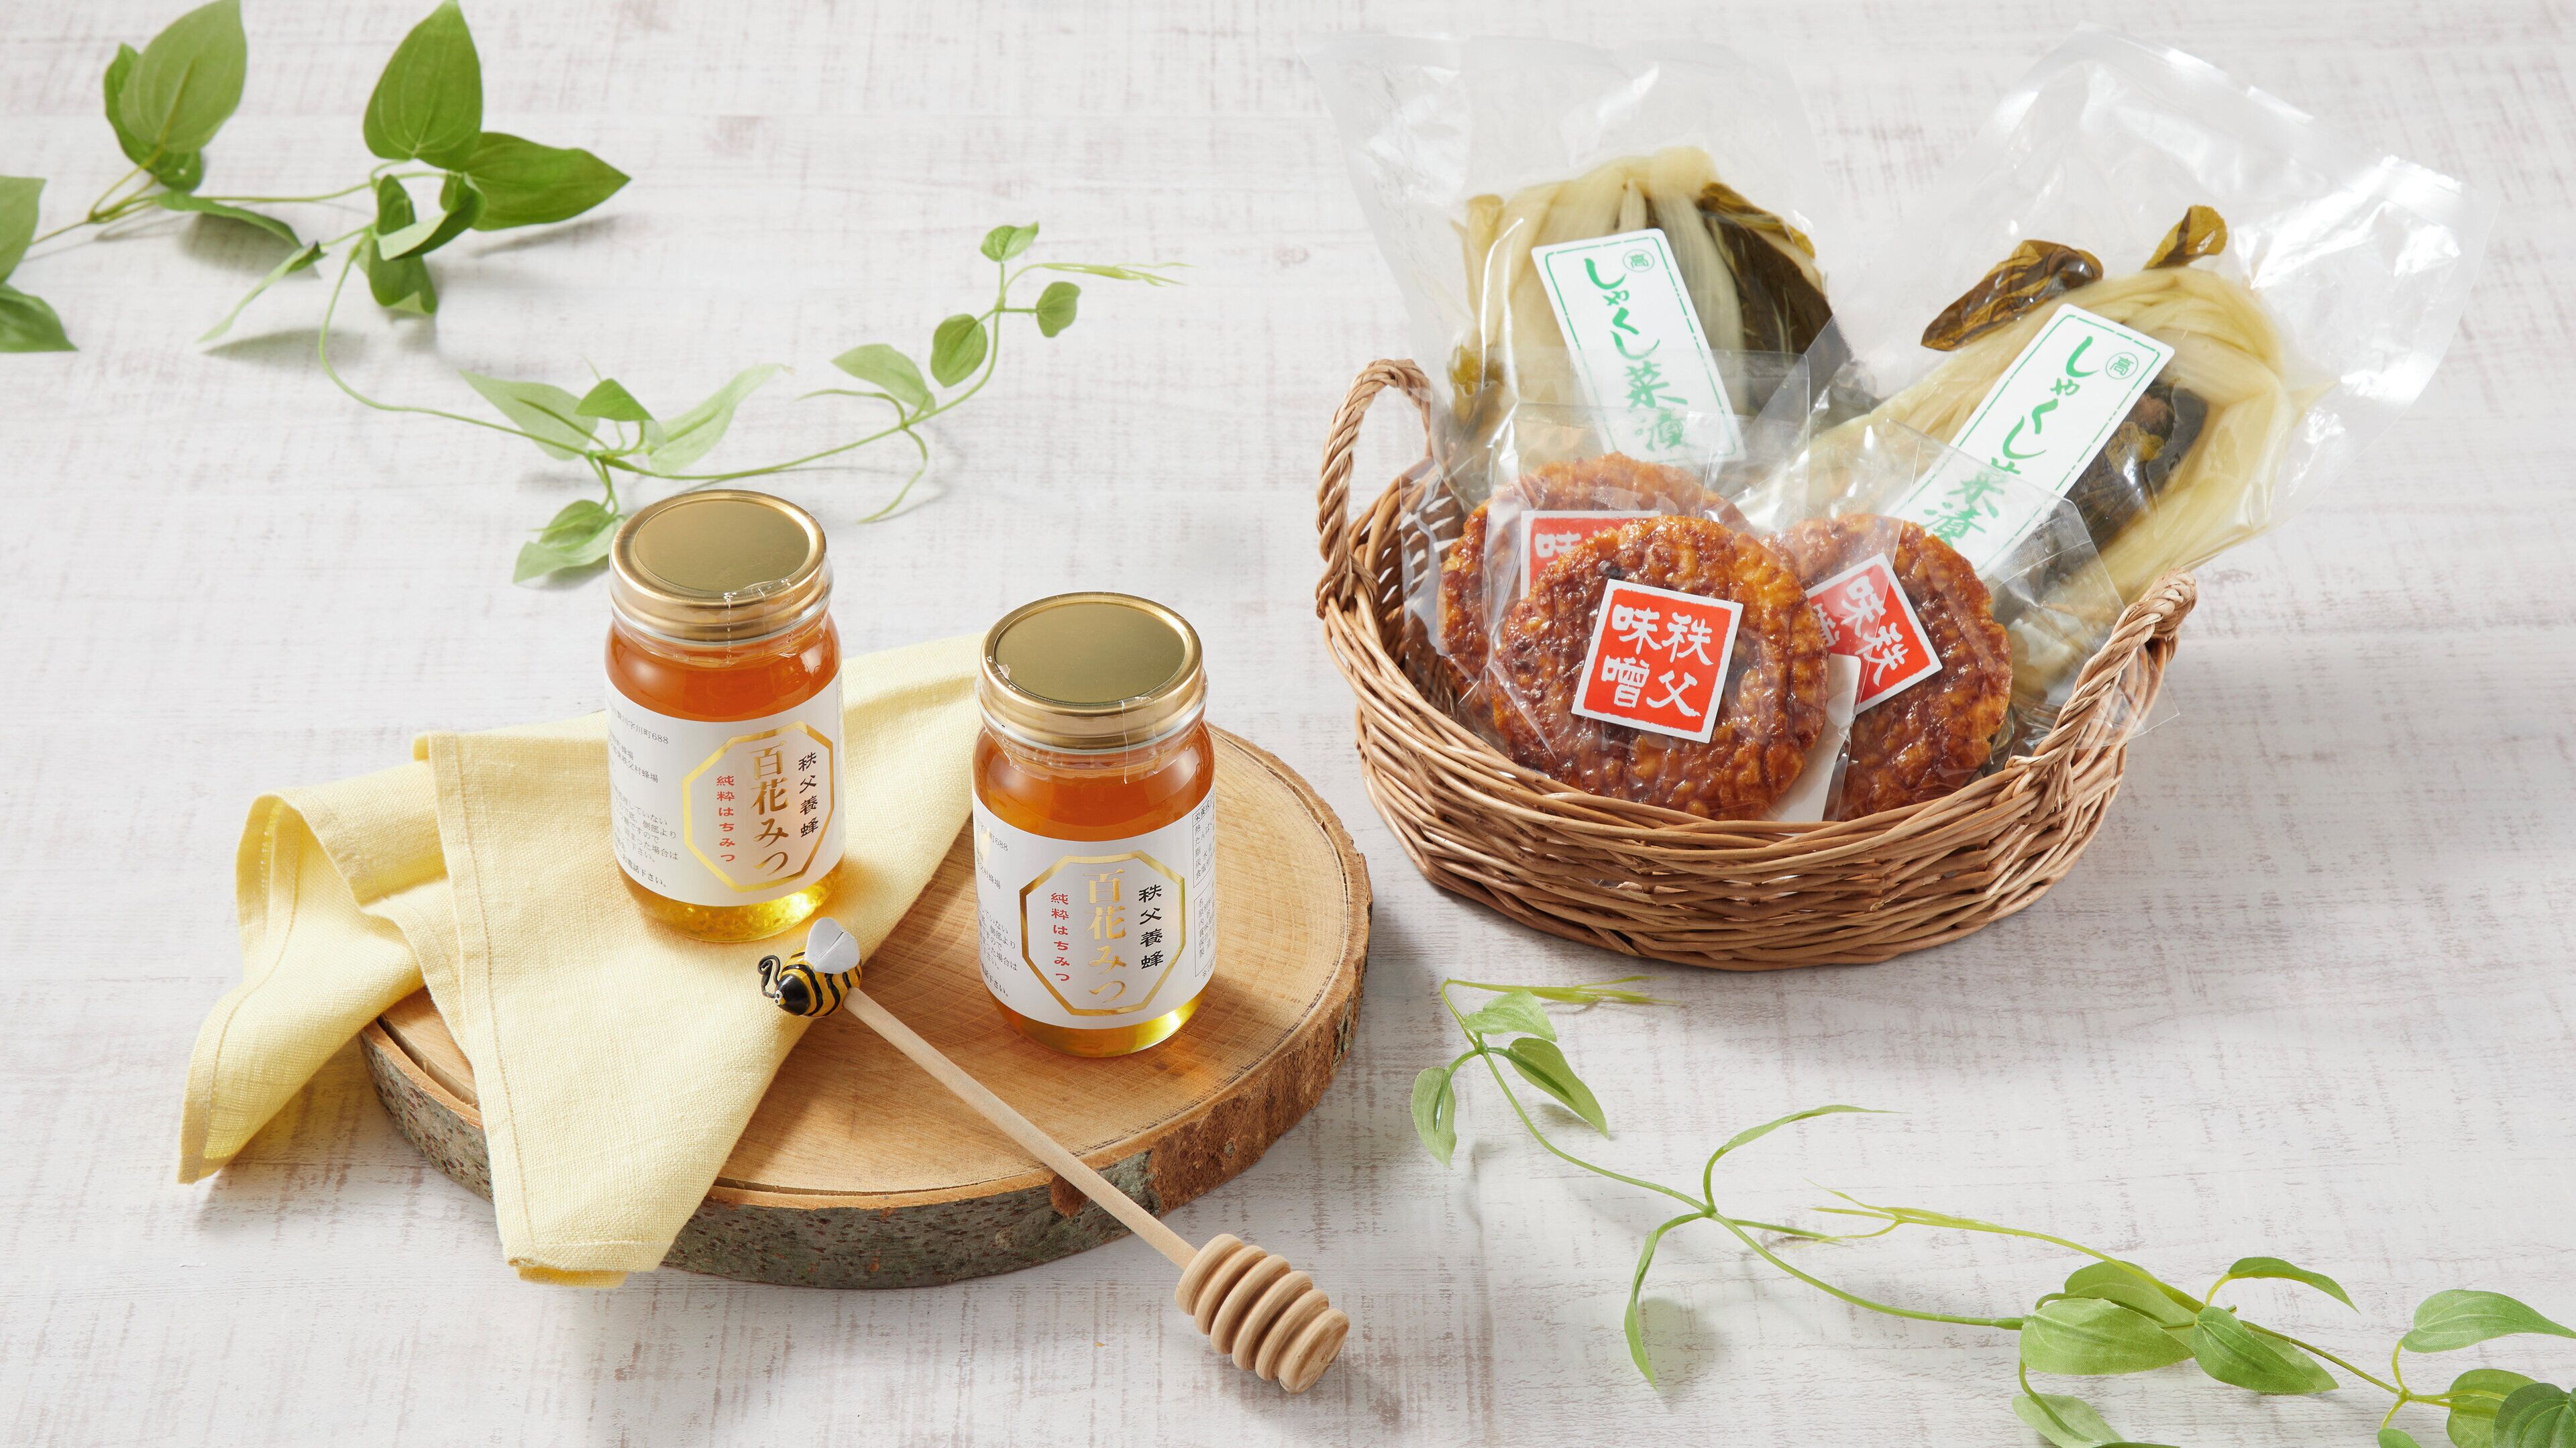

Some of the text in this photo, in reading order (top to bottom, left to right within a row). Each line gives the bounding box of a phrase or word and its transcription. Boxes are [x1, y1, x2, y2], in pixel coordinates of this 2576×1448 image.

[1600, 603, 1664, 709] 味噌
[1646, 610, 1715, 718] 秩父
[716, 775, 736, 862] 純粋はちみつ
[749, 740, 789, 876] 百花みつ
[798, 752, 818, 838] 秩父養蜂
[1051, 893, 1071, 981] 純粋はちみつ
[1083, 869, 1127, 1003] 百花みつ
[1138, 884, 1164, 970] 秩父養蜂
